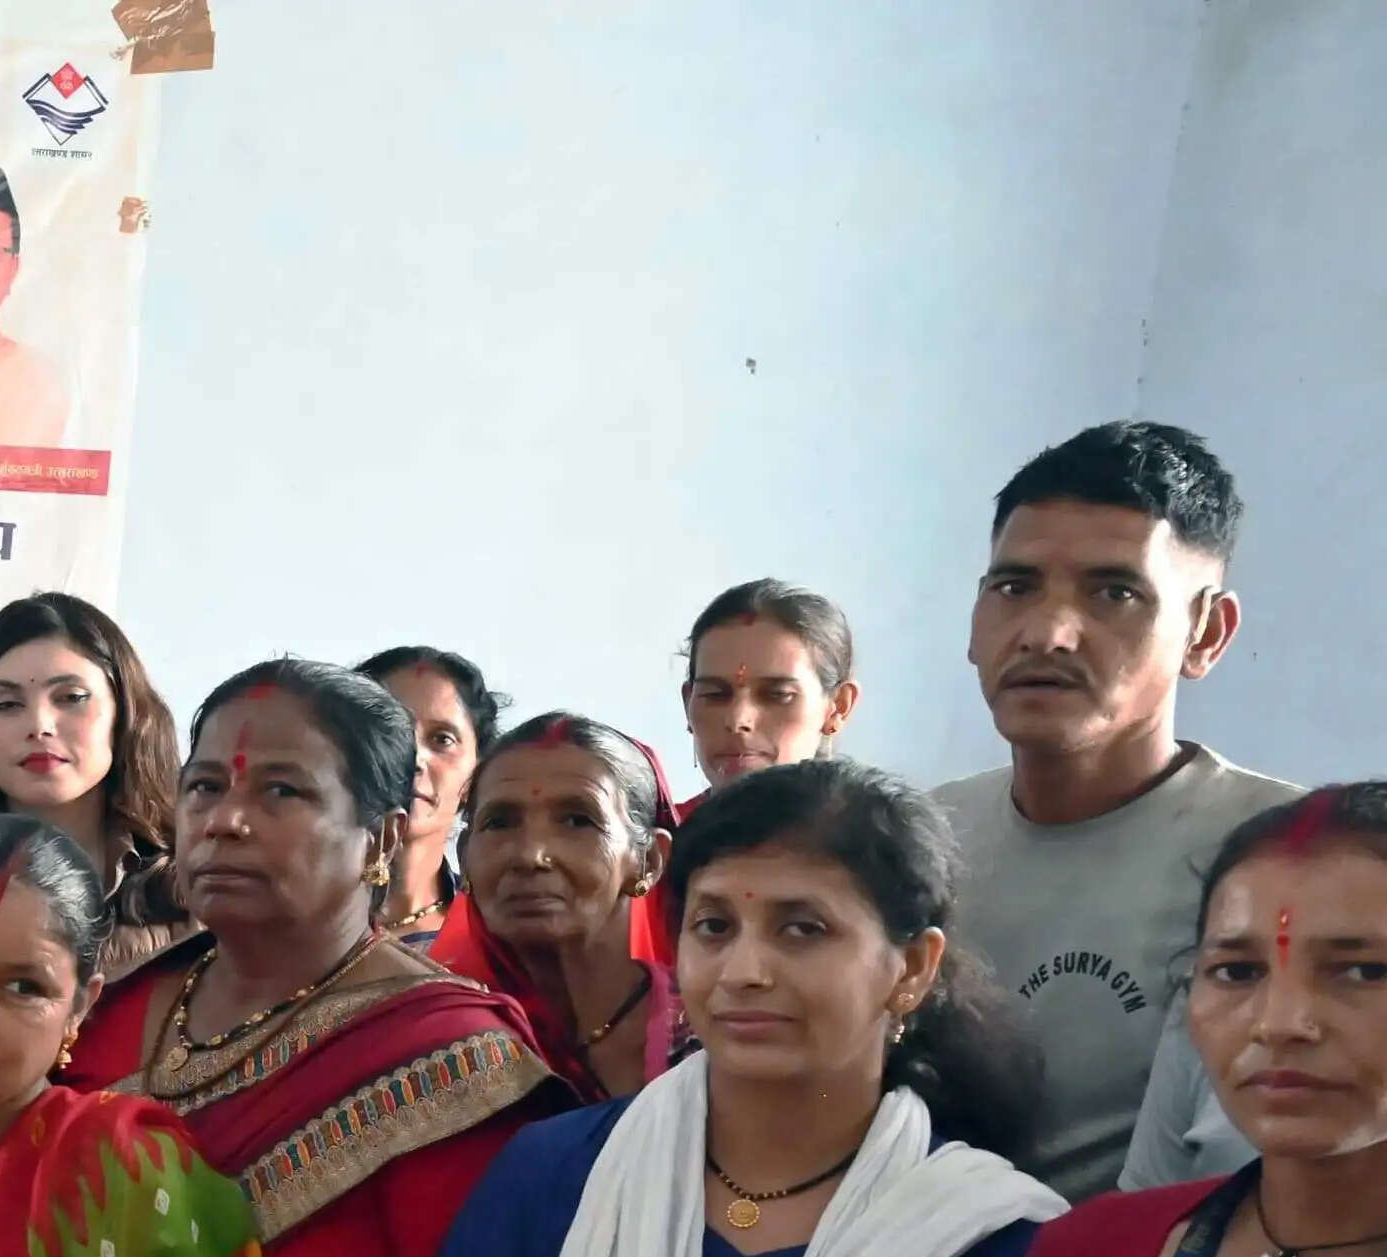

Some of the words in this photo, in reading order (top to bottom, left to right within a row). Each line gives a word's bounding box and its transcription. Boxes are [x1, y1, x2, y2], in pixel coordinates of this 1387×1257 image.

[1018, 963, 1049, 1000] THE
[1052, 951, 1112, 981] SURYA
[1110, 970, 1147, 1014] GYM
